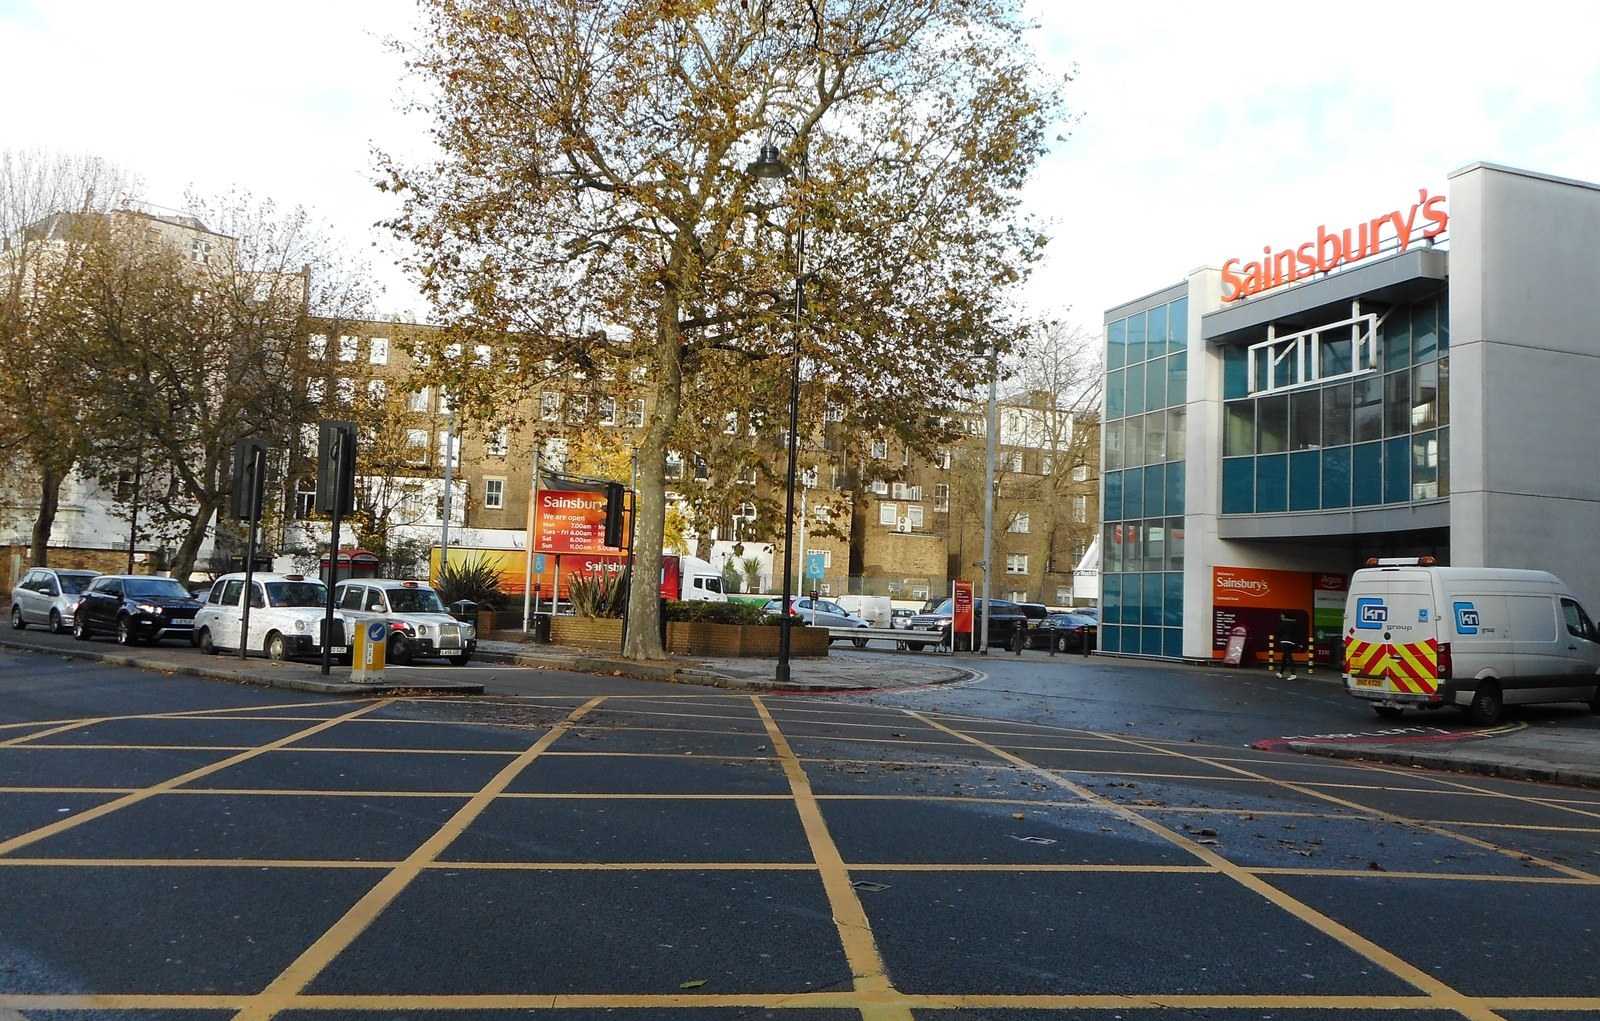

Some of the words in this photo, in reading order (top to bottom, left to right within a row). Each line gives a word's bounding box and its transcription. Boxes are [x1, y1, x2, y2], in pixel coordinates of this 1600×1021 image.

[1221, 188, 1448, 303] Sainsbury's
[544, 496, 607, 512] Sainsbury
[1217, 577, 1268, 591] Sainsbury's
[1364, 606, 1386, 620] kn
[1461, 611, 1478, 625] kn
